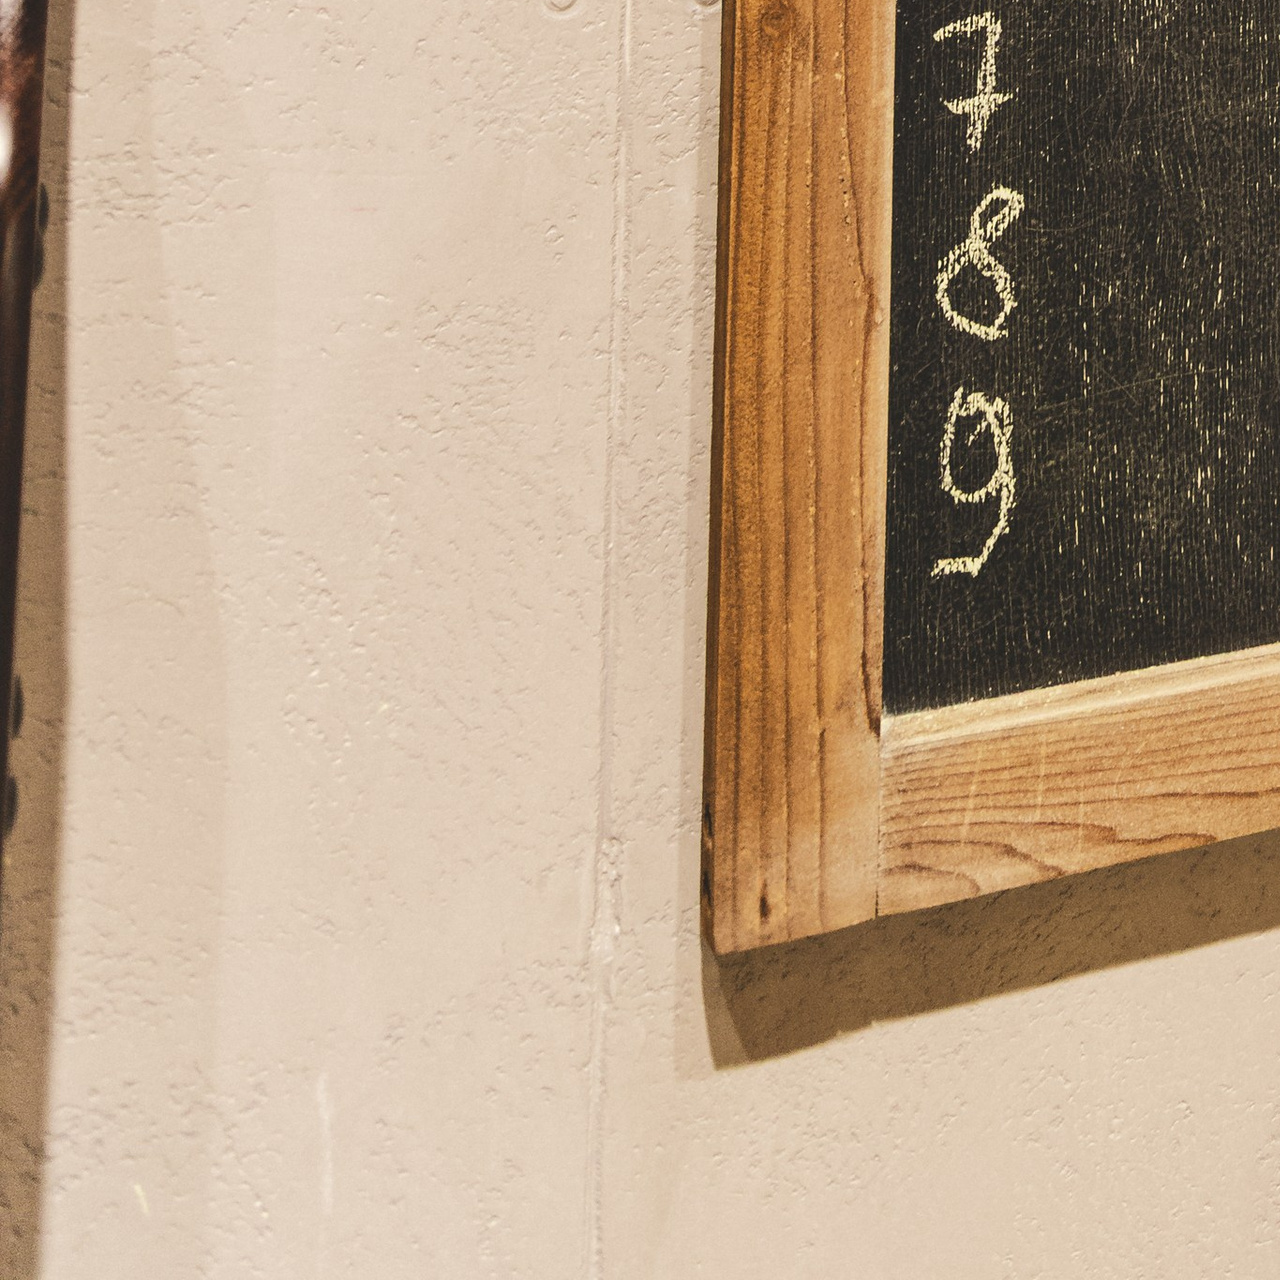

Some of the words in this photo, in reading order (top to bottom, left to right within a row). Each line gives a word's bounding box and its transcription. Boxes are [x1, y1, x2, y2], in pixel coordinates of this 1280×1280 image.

[932, 11, 1015, 152] 7
[937, 185, 1025, 342] 8
[930, 386, 1016, 578] 9
